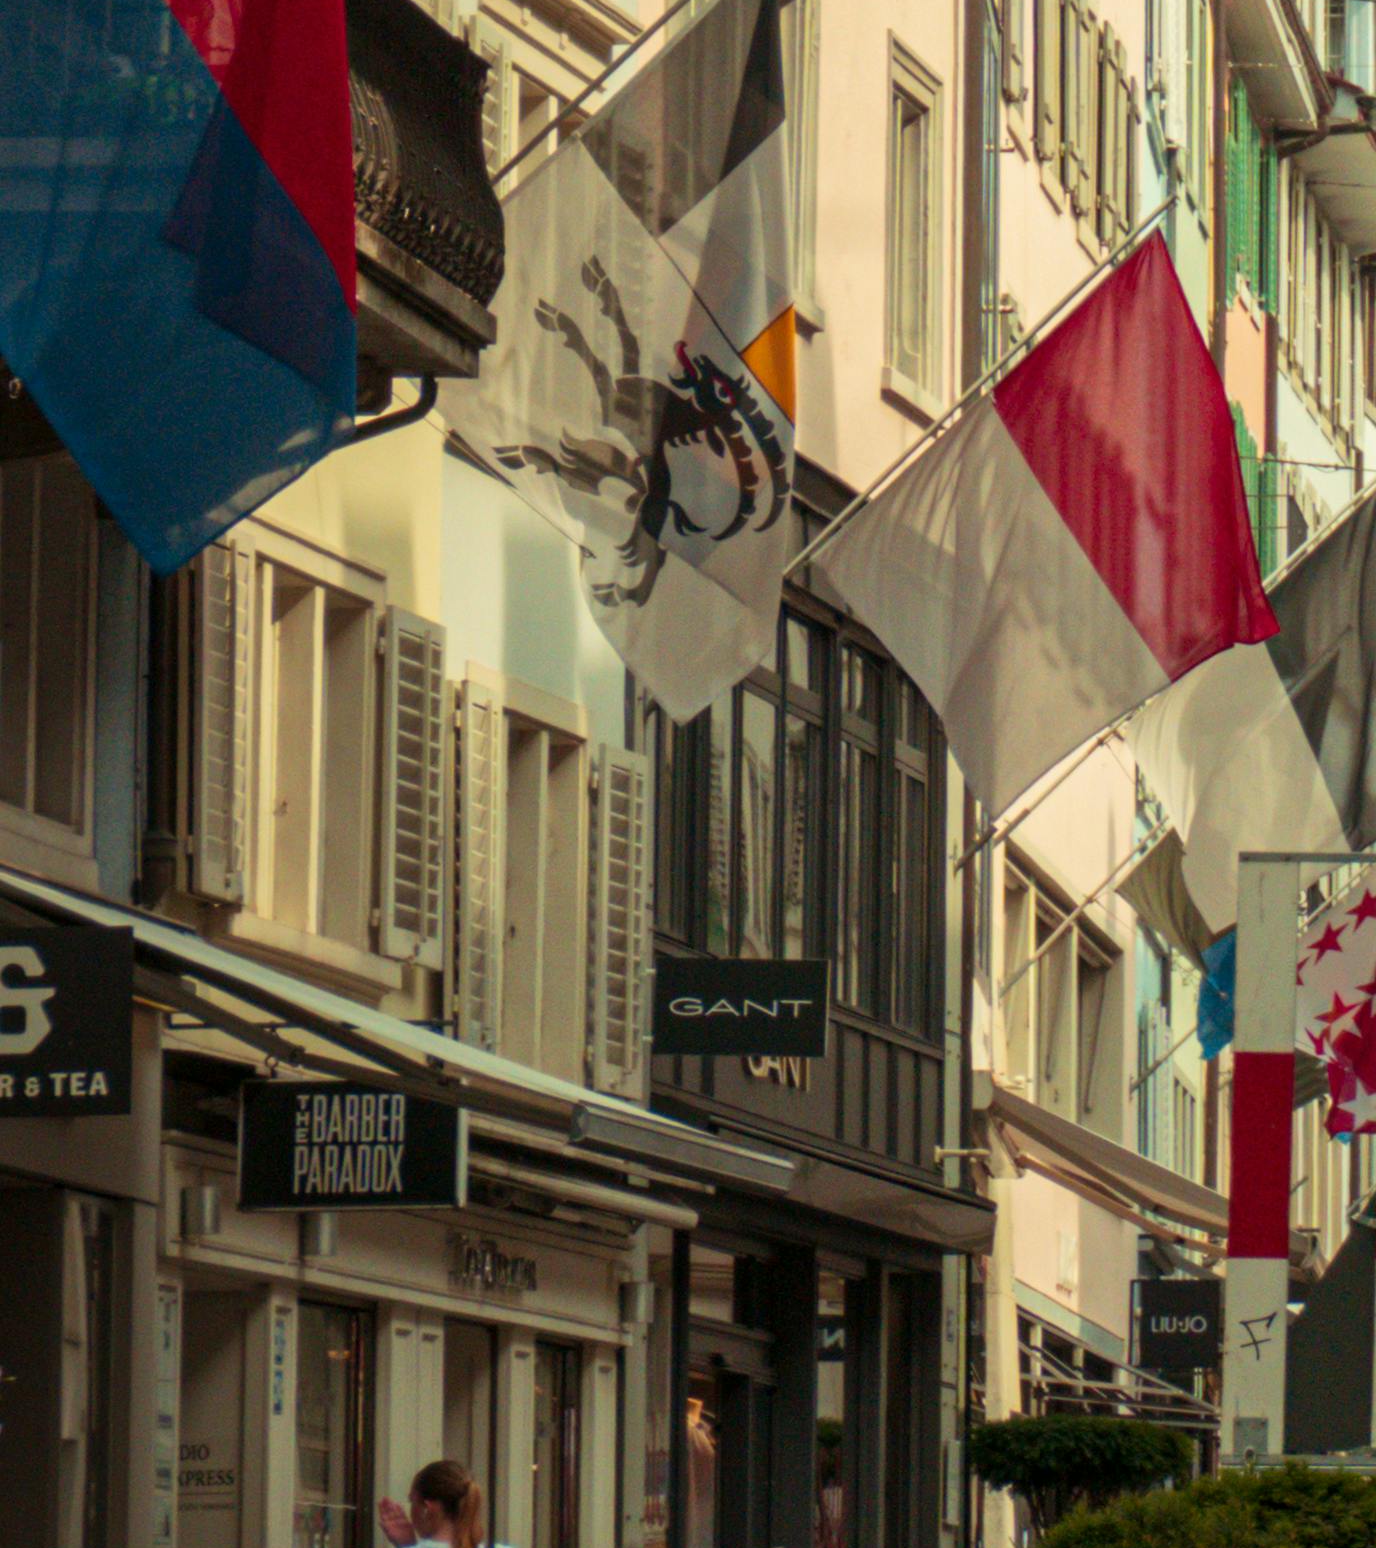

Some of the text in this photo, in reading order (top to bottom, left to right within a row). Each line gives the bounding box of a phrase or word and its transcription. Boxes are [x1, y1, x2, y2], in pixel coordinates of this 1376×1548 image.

[669, 997, 813, 1017] GANT
[48, 1072, 110, 1097] TEA
[312, 1094, 405, 1142] BARBER
[293, 1145, 403, 1194] PARADOX
